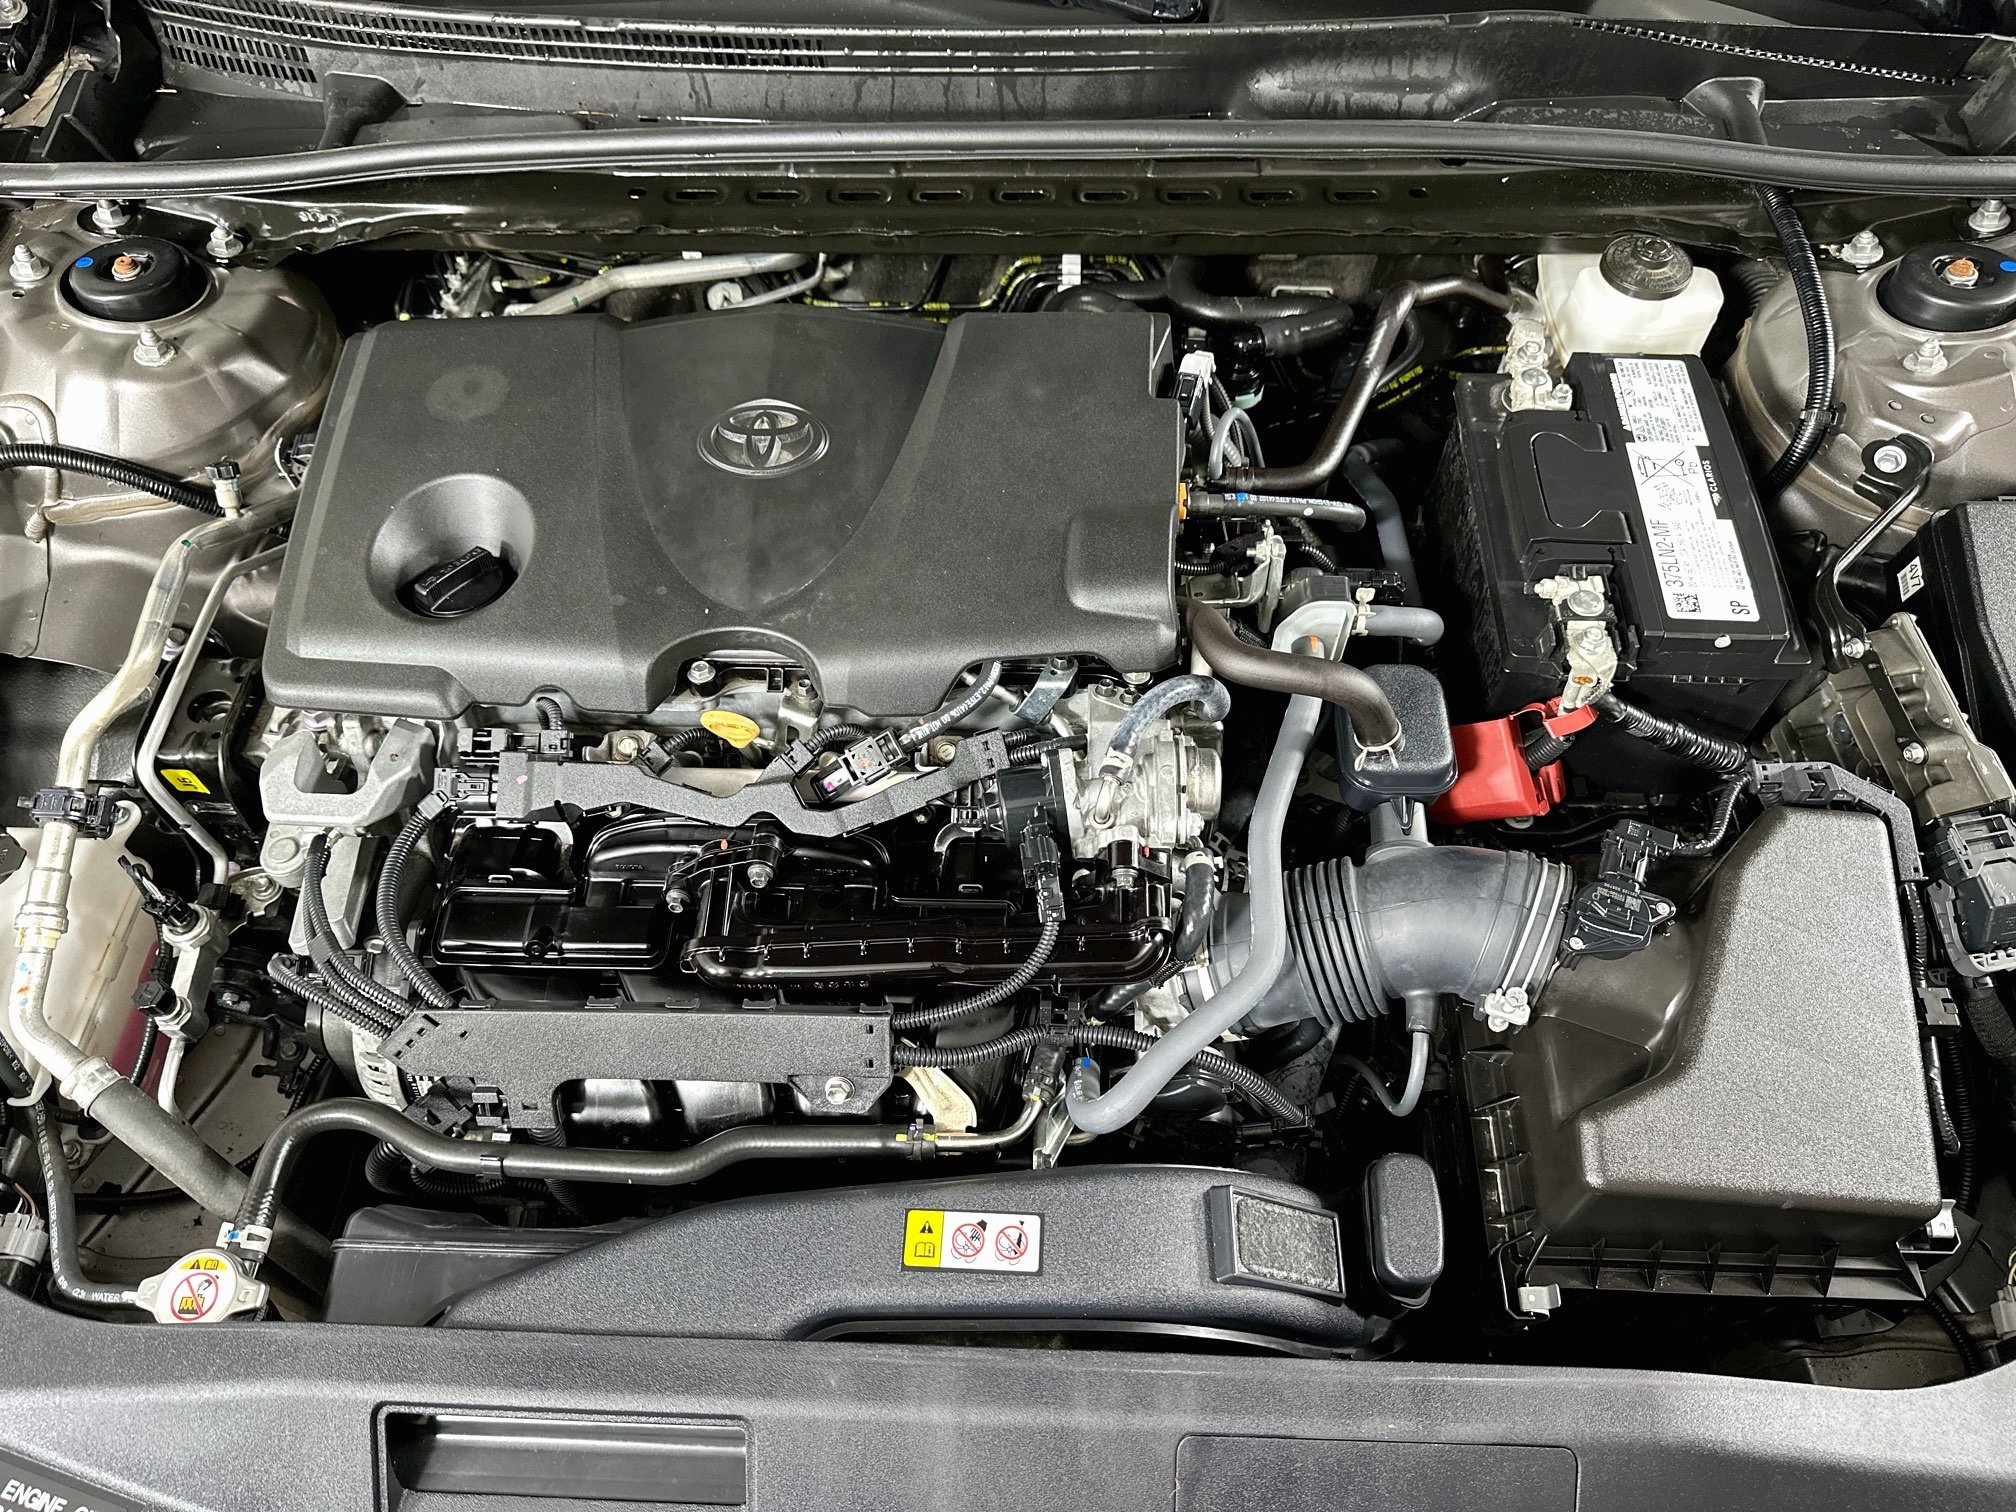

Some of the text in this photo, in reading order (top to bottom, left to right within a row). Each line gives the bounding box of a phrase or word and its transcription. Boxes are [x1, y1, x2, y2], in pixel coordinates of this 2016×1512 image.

[1701, 460, 1719, 492] CLARIOS
[1649, 519, 1684, 588] 375LN2-MF
[1908, 563, 1922, 588] 4V7
[1729, 600, 1751, 615] SP
[615, 863, 646, 872] TOYOTA
[0, 1478, 68, 1512] ENGINE
